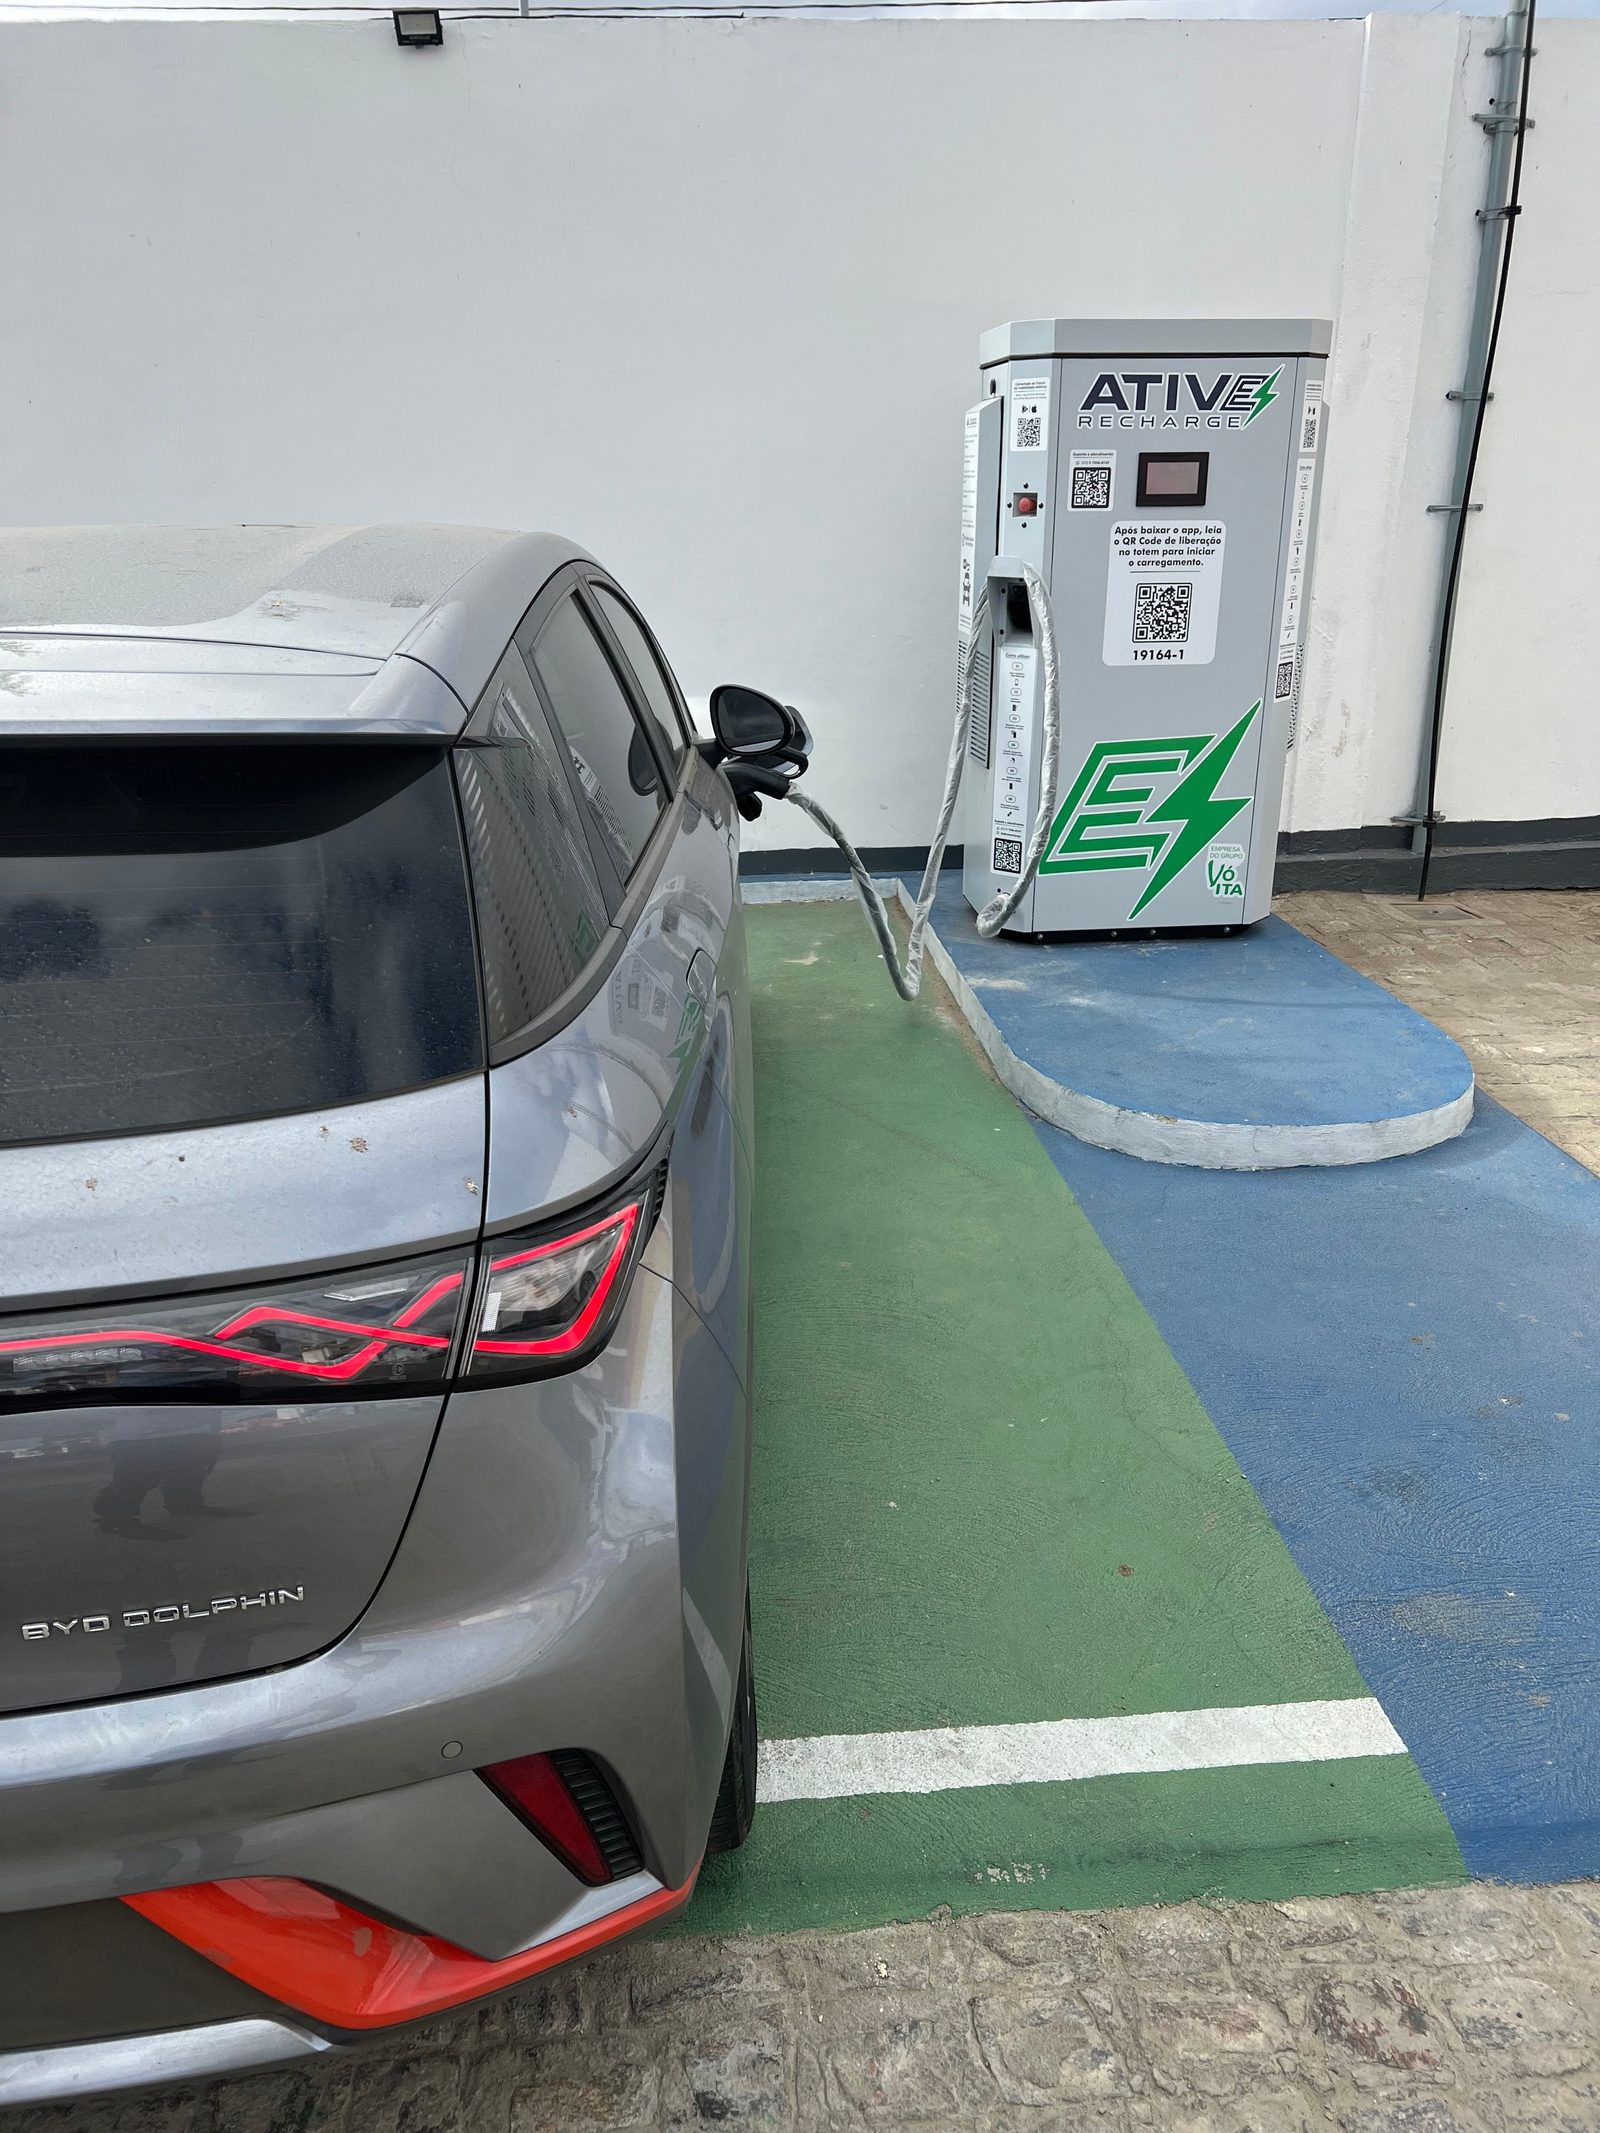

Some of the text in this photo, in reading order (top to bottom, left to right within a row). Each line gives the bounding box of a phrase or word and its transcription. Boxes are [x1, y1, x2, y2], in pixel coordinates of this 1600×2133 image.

[1078, 415, 1241, 429] RECHARGE
[1114, 526, 1138, 536] Após
[1140, 526, 1171, 534] baixar
[1181, 527, 1202, 536] app,
[1205, 525, 1222, 534] leia
[1122, 537, 1137, 546] QR
[1139, 536, 1162, 545] Code
[1164, 536, 1176, 545] de
[1178, 536, 1222, 547] liberação
[1133, 548, 1160, 556] totem
[1162, 549, 1184, 557] para
[1186, 547, 1216, 555] iniciar
[1137, 558, 1204, 568] carregamento.
[1133, 649, 1184, 661] 19164-1
[1215, 883, 1243, 896] ITA
[21, 1584, 304, 1641] BYD DOLPHIN
